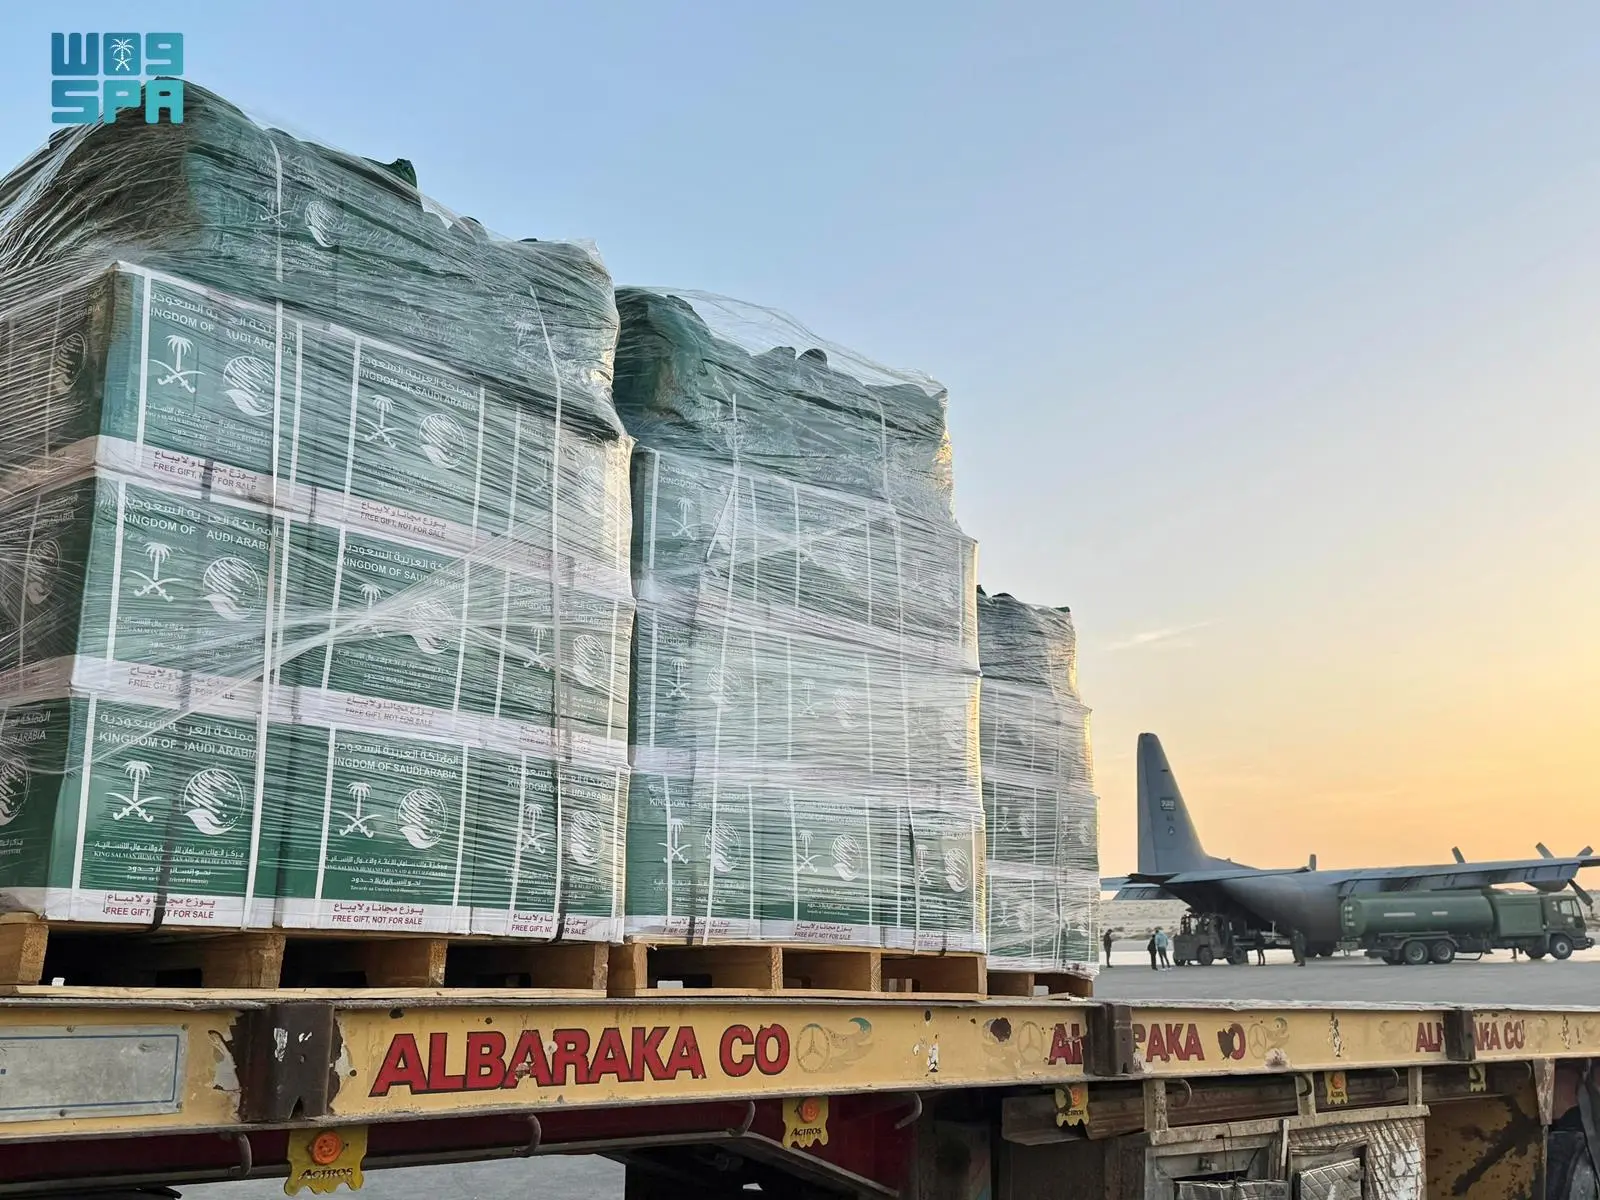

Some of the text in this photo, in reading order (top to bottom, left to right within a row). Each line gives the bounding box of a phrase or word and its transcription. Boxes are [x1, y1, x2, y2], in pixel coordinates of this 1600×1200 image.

[151, 308, 197, 328] INGDOM
[200, 321, 214, 332] OF
[253, 336, 293, 356] ARAIA
[360, 368, 398, 386] INGDOM
[153, 462, 178, 473] FREE
[217, 478, 234, 488] FOR
[360, 511, 379, 522] FREE
[398, 521, 412, 530] NOT
[413, 526, 427, 535] FOR
[428, 529, 446, 539] SALE
[180, 524, 196, 535] OF
[206, 529, 235, 544] AUDI
[235, 537, 271, 551] ARABI
[389, 567, 401, 577] OF
[161, 739, 176, 749] OF
[334, 757, 375, 770] INGDOM
[378, 761, 391, 771] OF
[107, 907, 129, 915] FREE
[332, 915, 351, 923] FREE
[353, 916, 370, 924] GIFT,
[404, 917, 422, 925] SALE
[529, 925, 544, 933] GIFT,
[1504, 1020, 1526, 1050] CO
[369, 1023, 790, 1097] ALBARAKA CO
